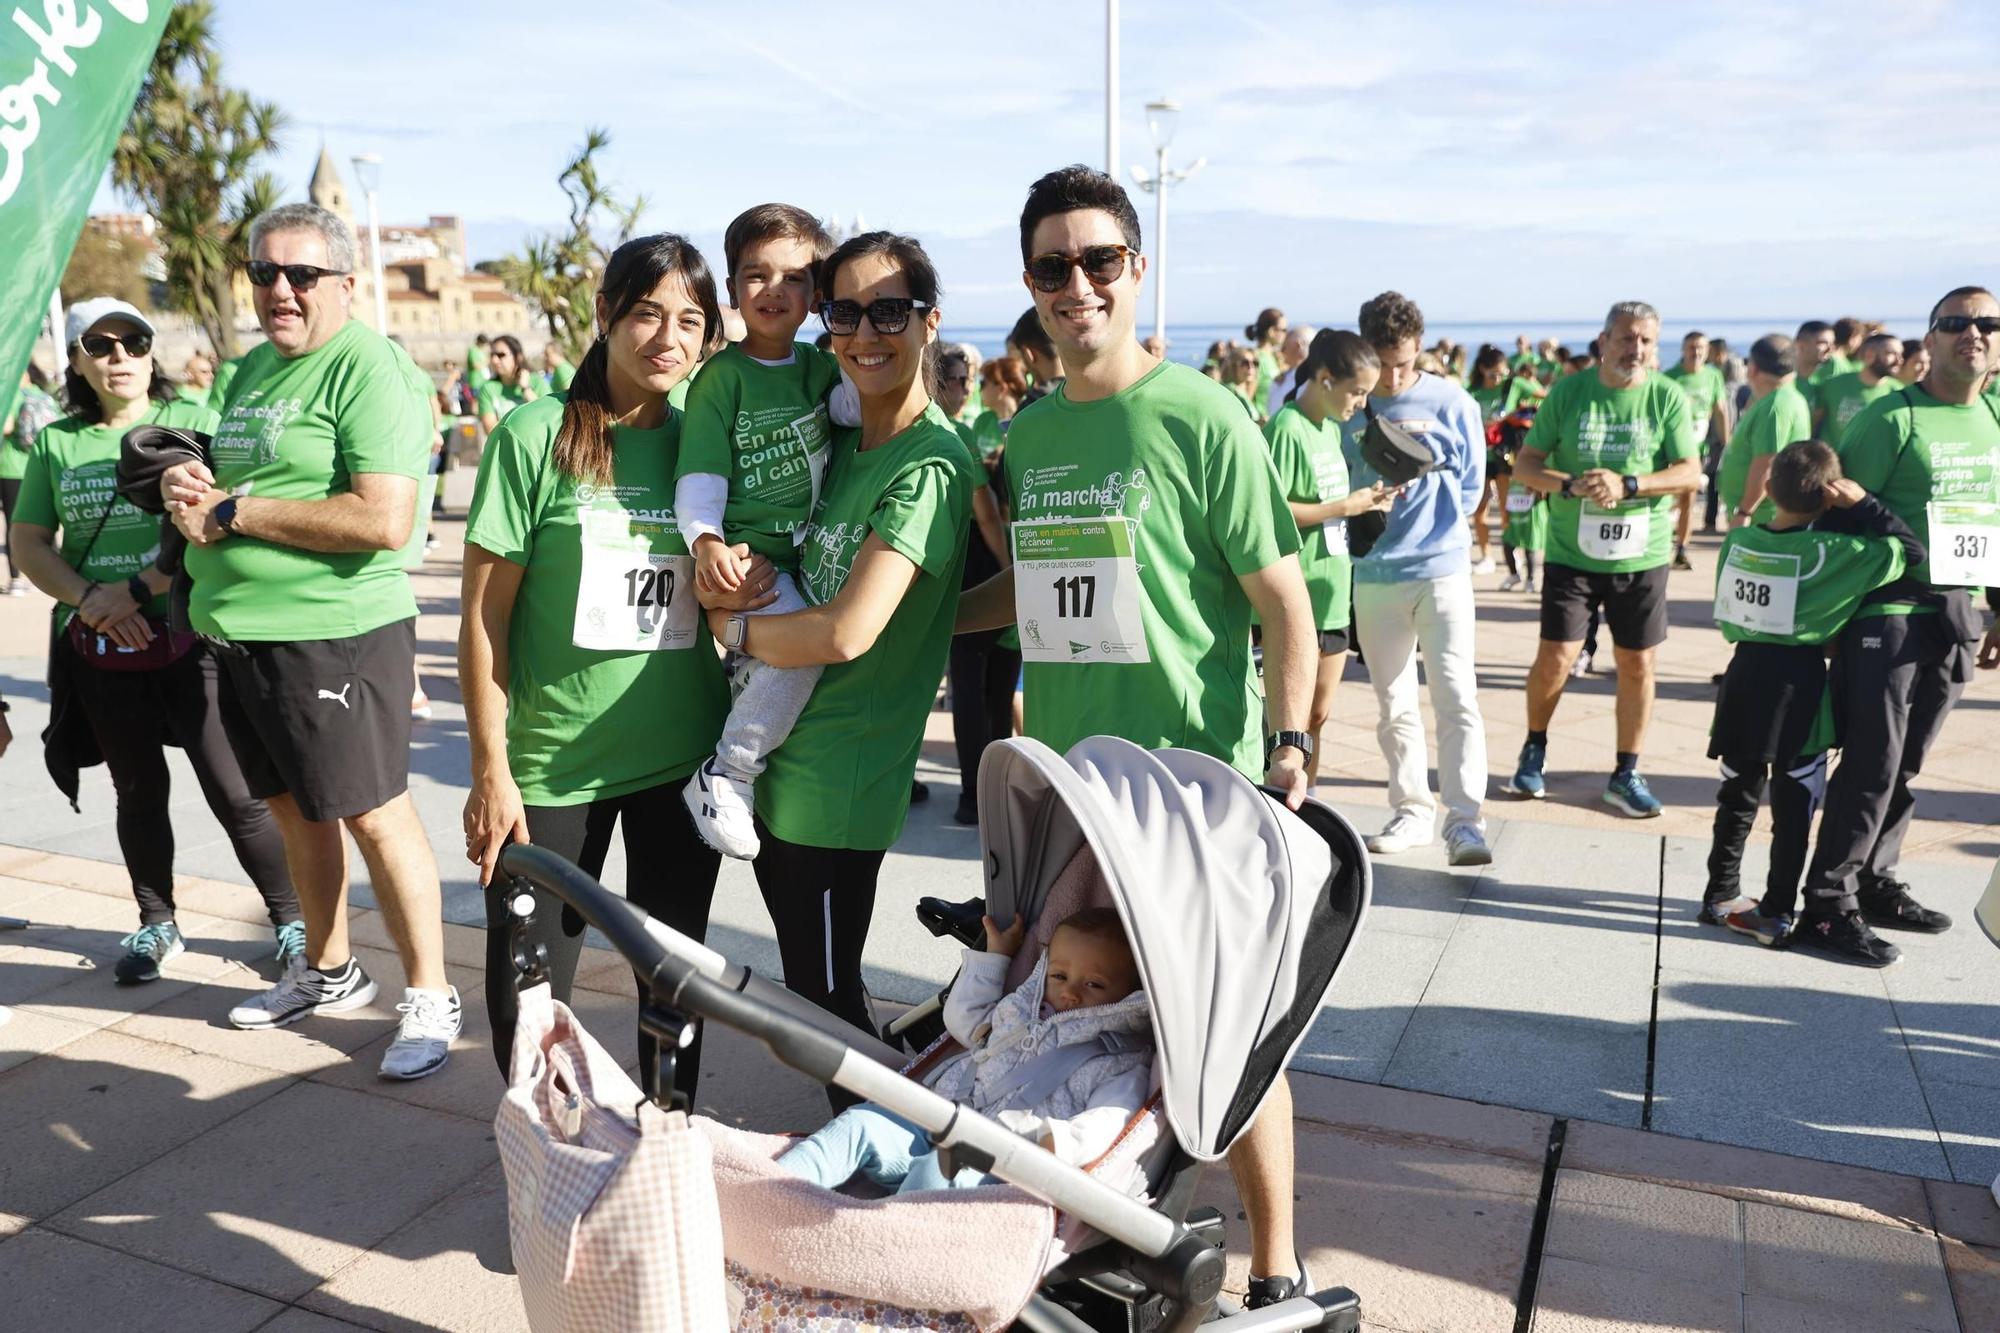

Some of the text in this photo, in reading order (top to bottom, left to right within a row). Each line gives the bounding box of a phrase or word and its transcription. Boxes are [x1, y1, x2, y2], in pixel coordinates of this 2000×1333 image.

[736, 433, 766, 450] En
[61, 479, 81, 492] En
[744, 467, 762, 489] el
[1020, 484, 1113, 511] En marcha
[66, 508, 80, 522] el
[1019, 526, 1106, 540] Gijón en marcha contra
[1600, 523, 1631, 540] 697
[1019, 537, 1054, 548] el cáncer
[1954, 535, 1988, 558] 337
[1068, 560, 1096, 569] CORRES?
[624, 568, 675, 608] 120
[1735, 578, 1771, 607] 338
[1053, 576, 1096, 618] 117
